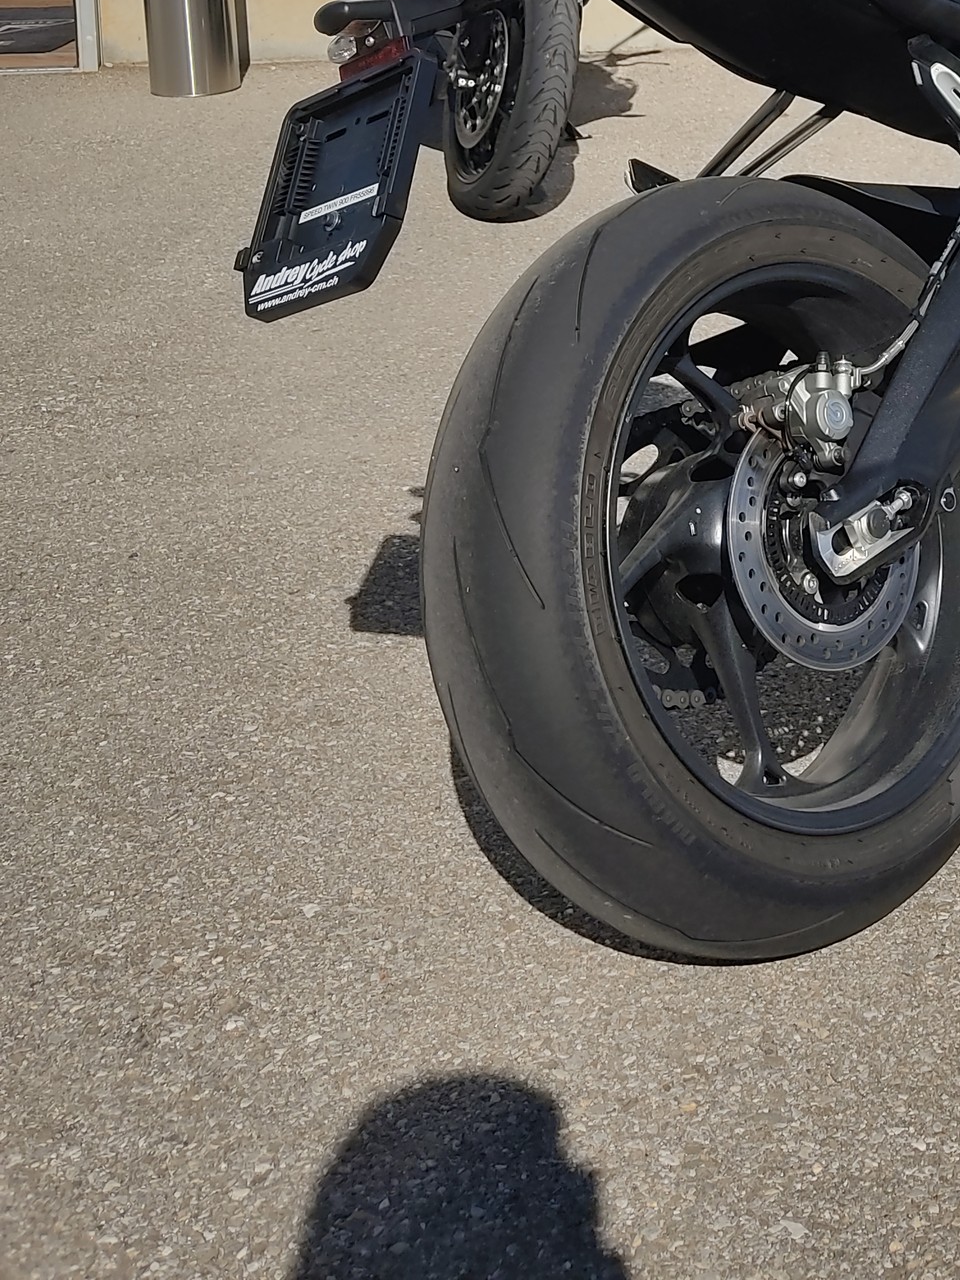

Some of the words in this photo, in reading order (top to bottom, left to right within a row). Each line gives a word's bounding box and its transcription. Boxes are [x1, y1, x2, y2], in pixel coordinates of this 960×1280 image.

[303, 206, 323, 220] SPEED
[250, 261, 311, 297] Andrey
[305, 250, 337, 281] Cycle
[336, 239, 368, 266] shop
[257, 275, 339, 312] www.andrey-cm.ch
